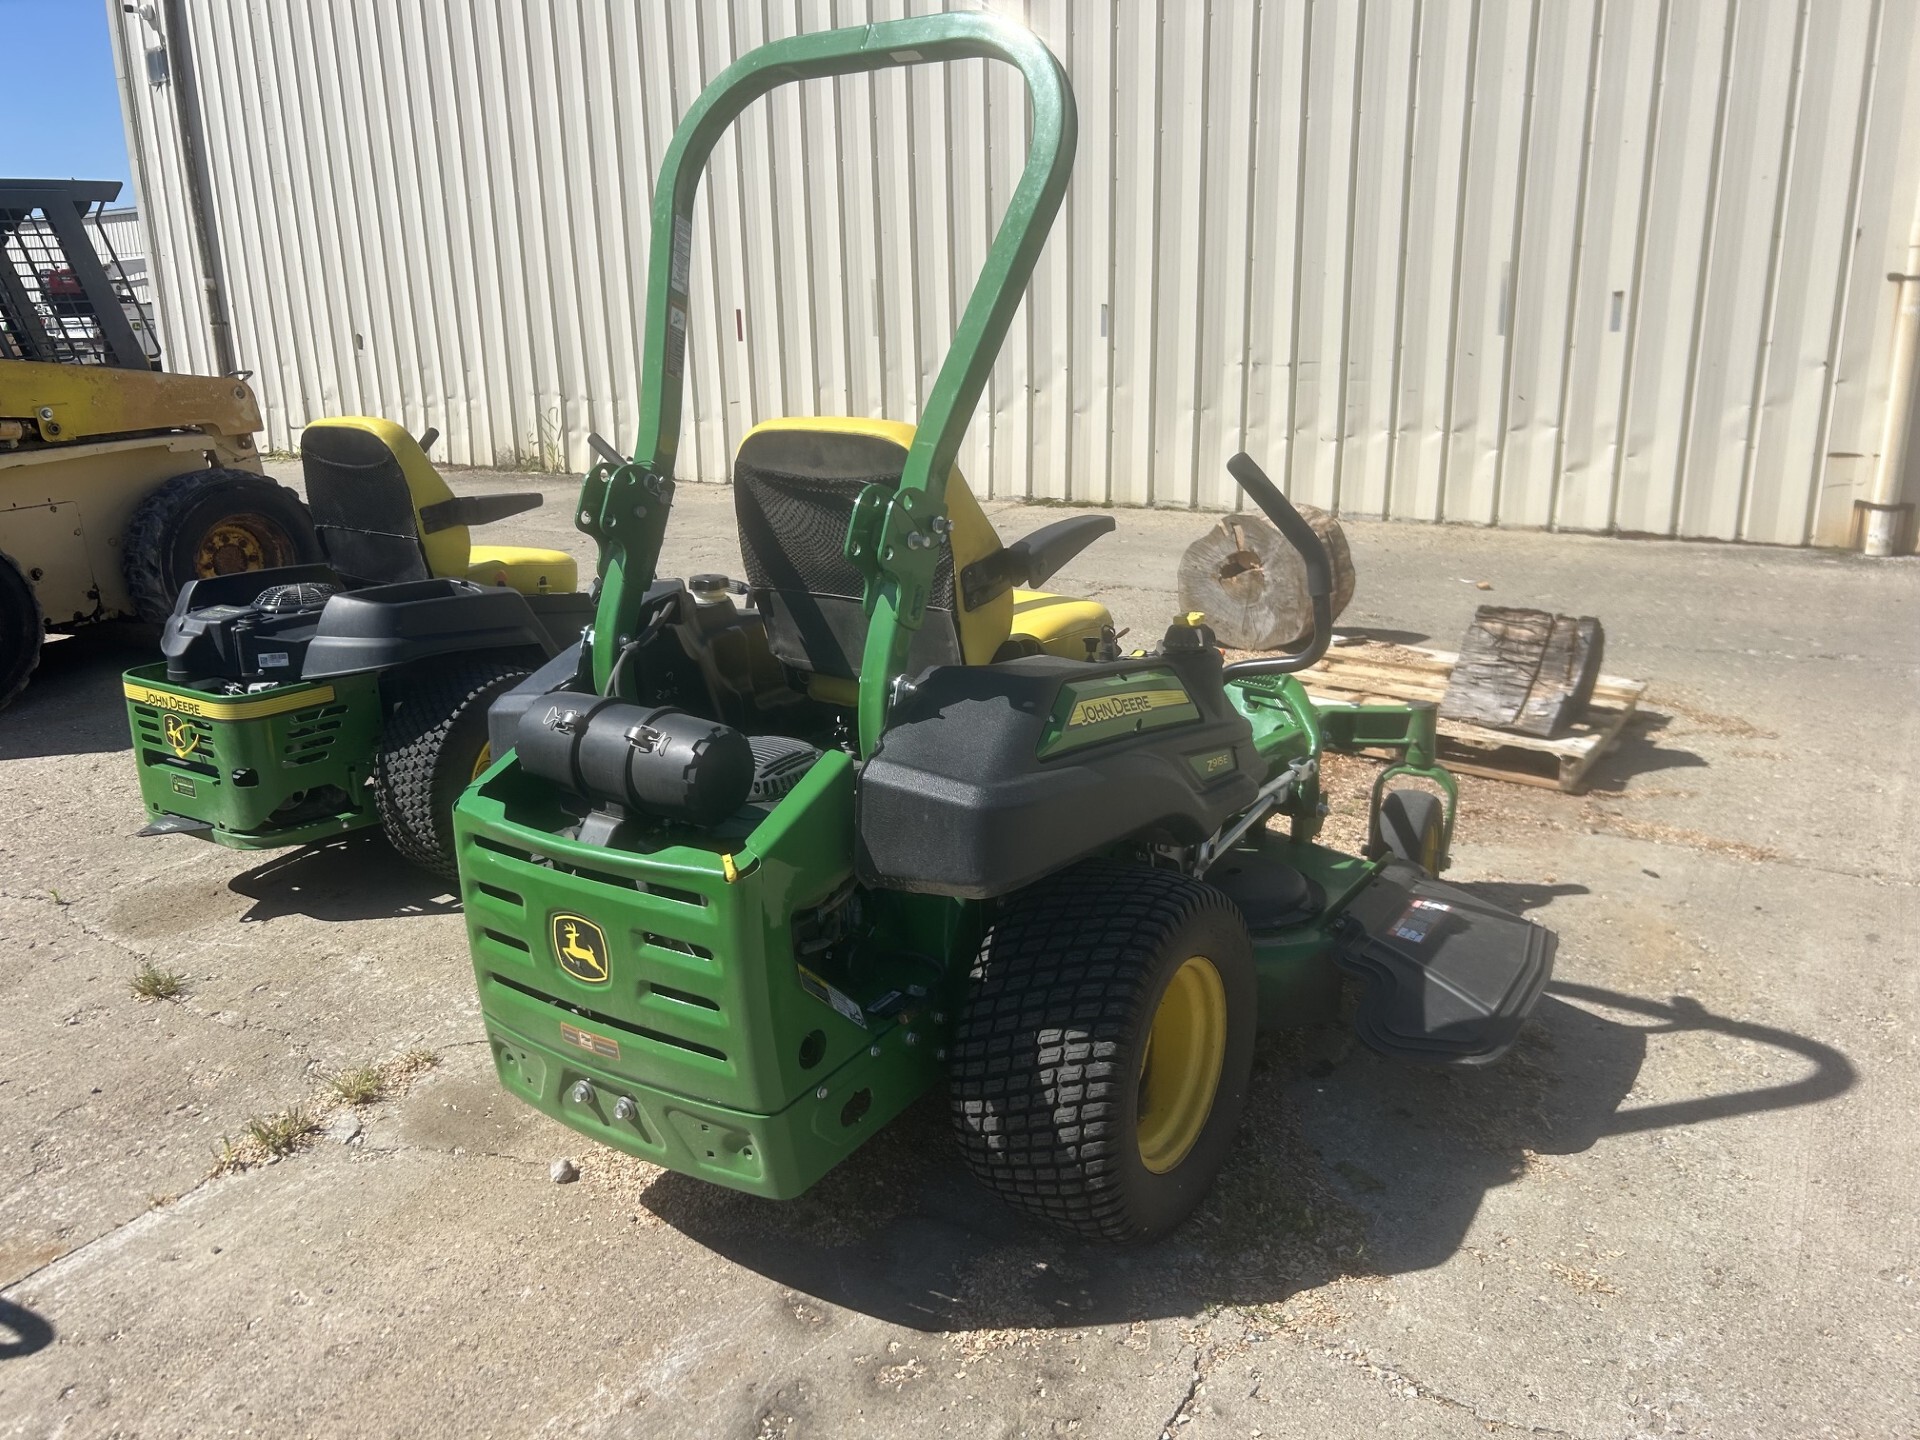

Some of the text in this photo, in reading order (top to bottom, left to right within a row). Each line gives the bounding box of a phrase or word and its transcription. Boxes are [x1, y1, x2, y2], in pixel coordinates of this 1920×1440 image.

[145, 690, 201, 715] JOHN DEERE
[1081, 696, 1152, 723] JOHN DEERE
